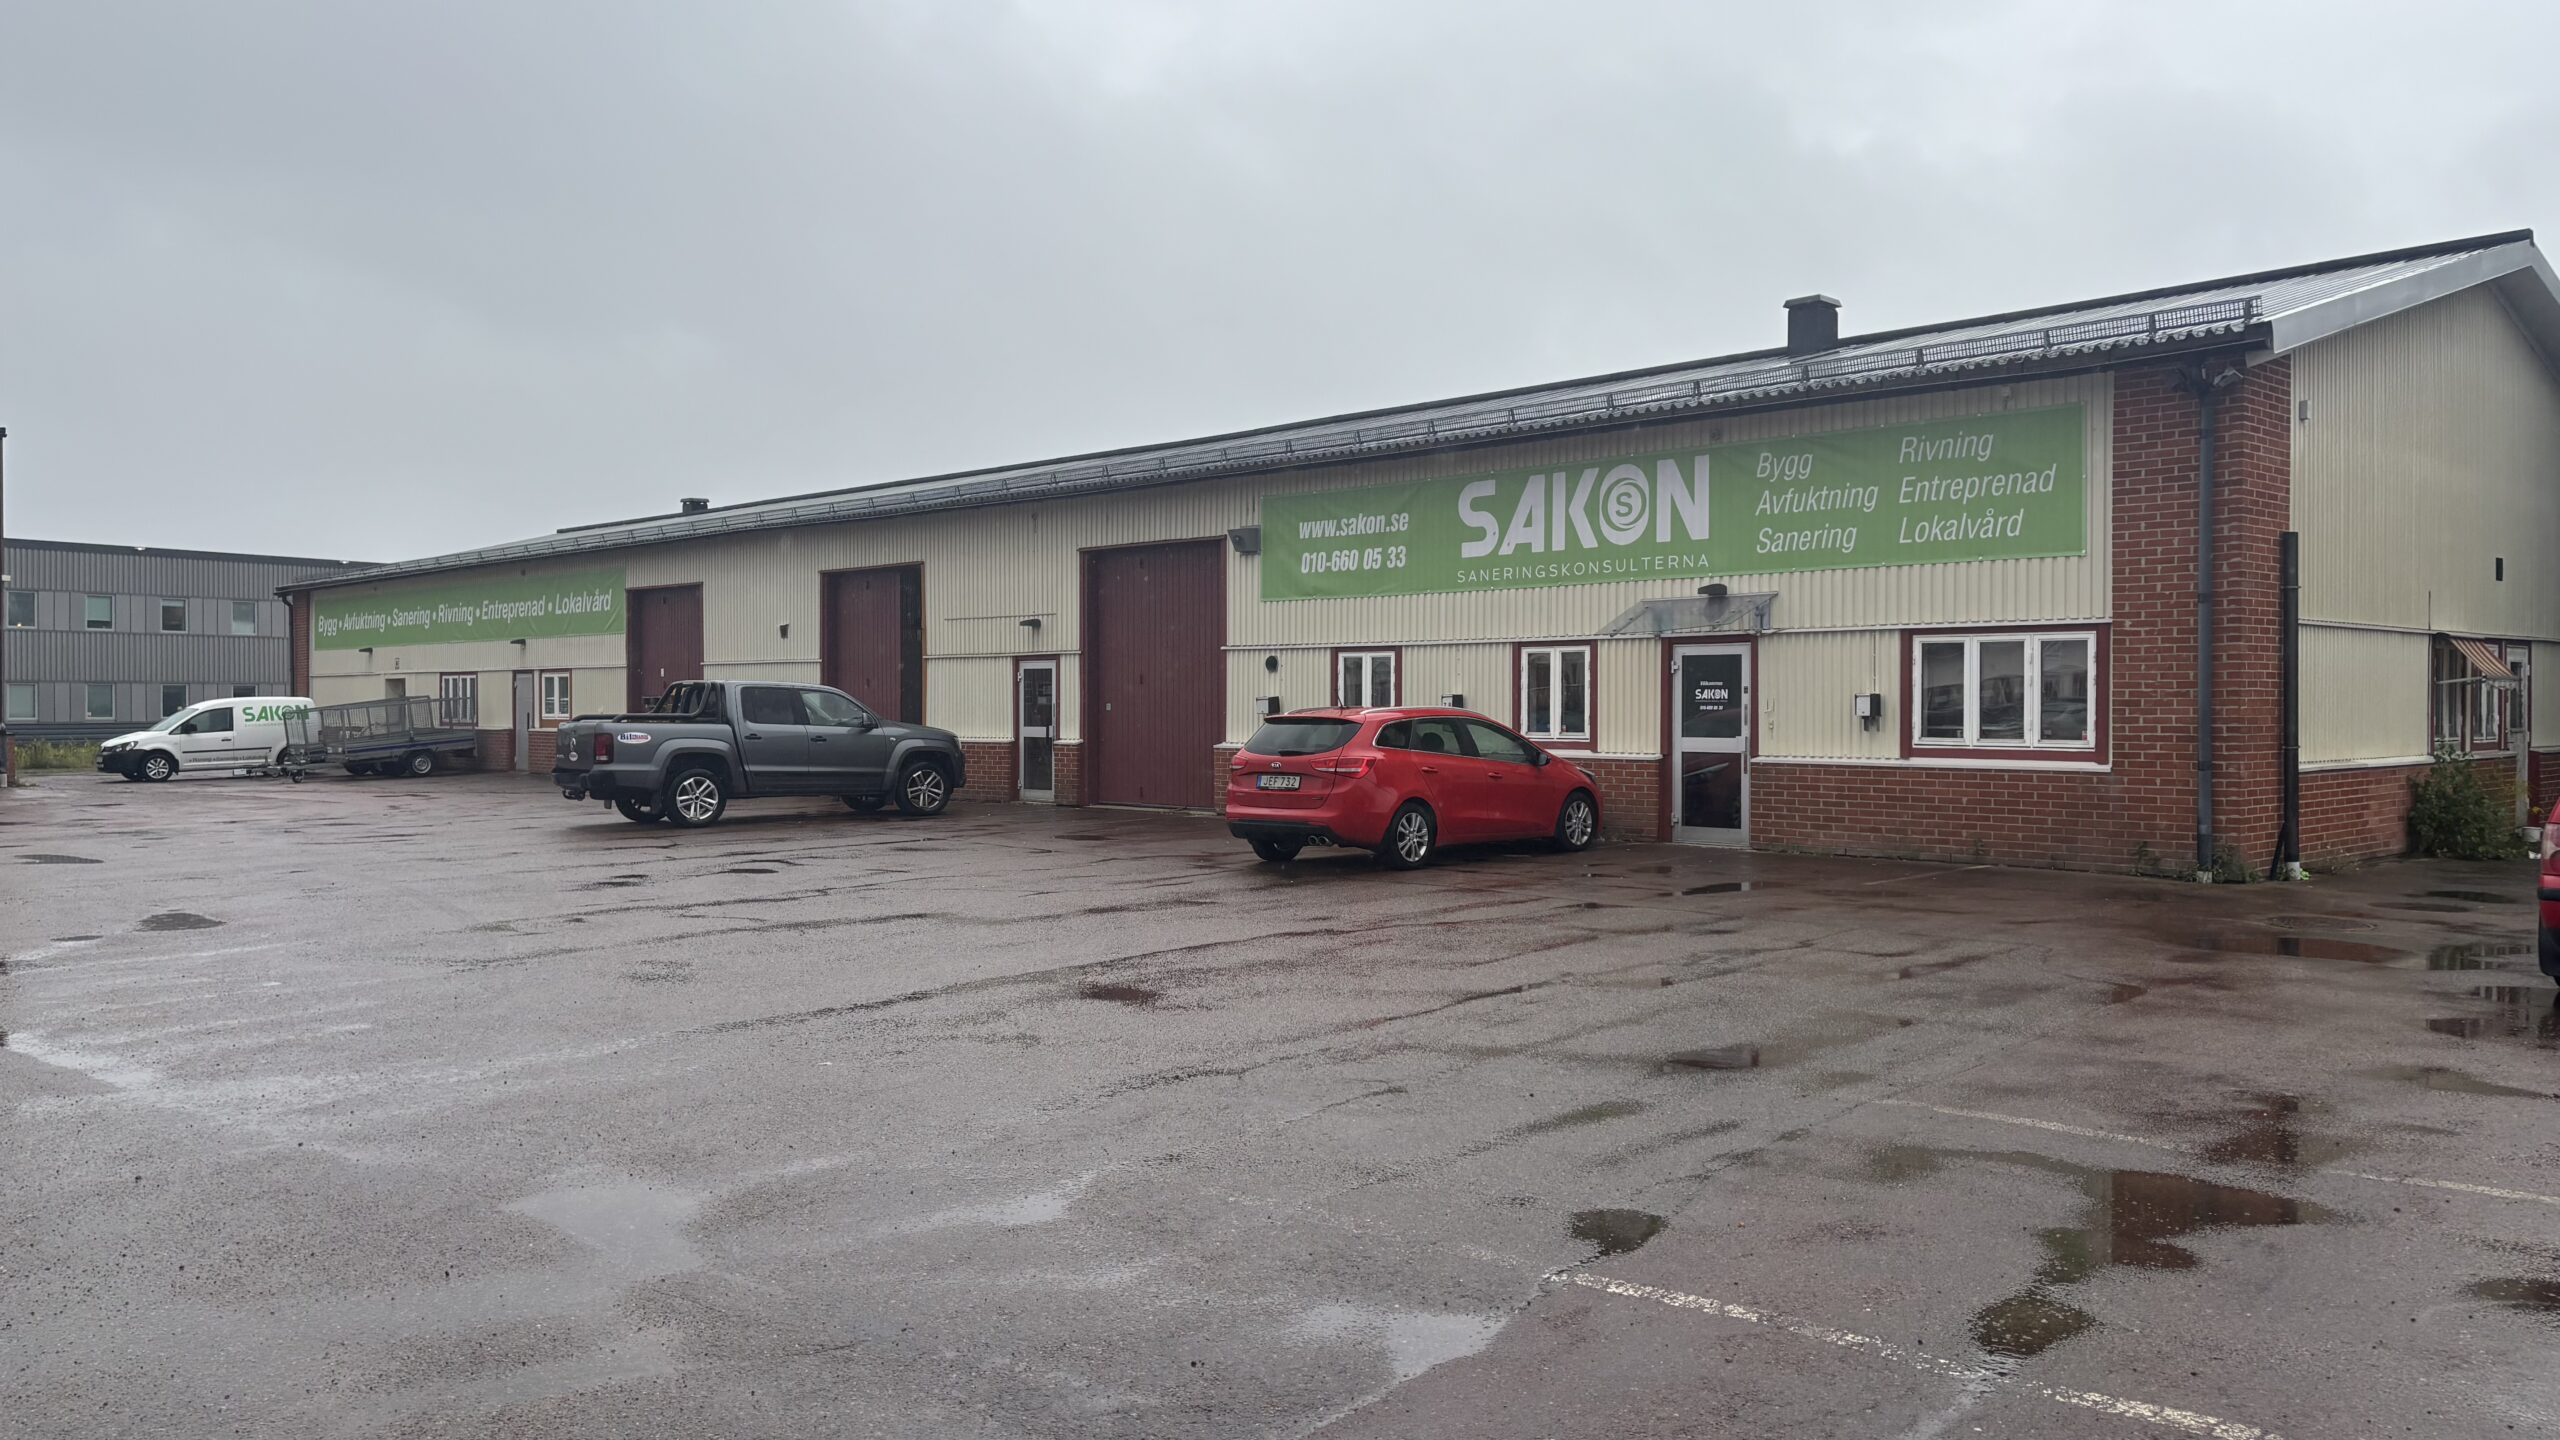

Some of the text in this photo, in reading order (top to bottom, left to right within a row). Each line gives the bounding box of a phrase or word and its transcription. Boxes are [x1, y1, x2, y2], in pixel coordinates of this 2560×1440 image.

[1899, 431, 1994, 463] Rivning
[1756, 452, 1813, 482] Bygg
[1899, 463, 2057, 505] Entreprenad
[1458, 454, 1710, 559] SAKON
[1755, 483, 1879, 516] Avfuktning
[1299, 512, 1409, 539] www.sakon.se
[1756, 523, 1857, 553] Sanering
[1899, 508, 2025, 544] Lokalvård
[1301, 546, 1407, 574] 010-660 05 33
[1457, 553, 1710, 584] SANERINGSKONSULTERNA
[318, 588, 613, 637] Bygg Avfuktning Sanering Rivning Entreprenad Lokalvård
[1695, 688, 1729, 700] SAKON
[242, 704, 310, 722] SAKON
[1263, 776, 1297, 787] JEF 732
